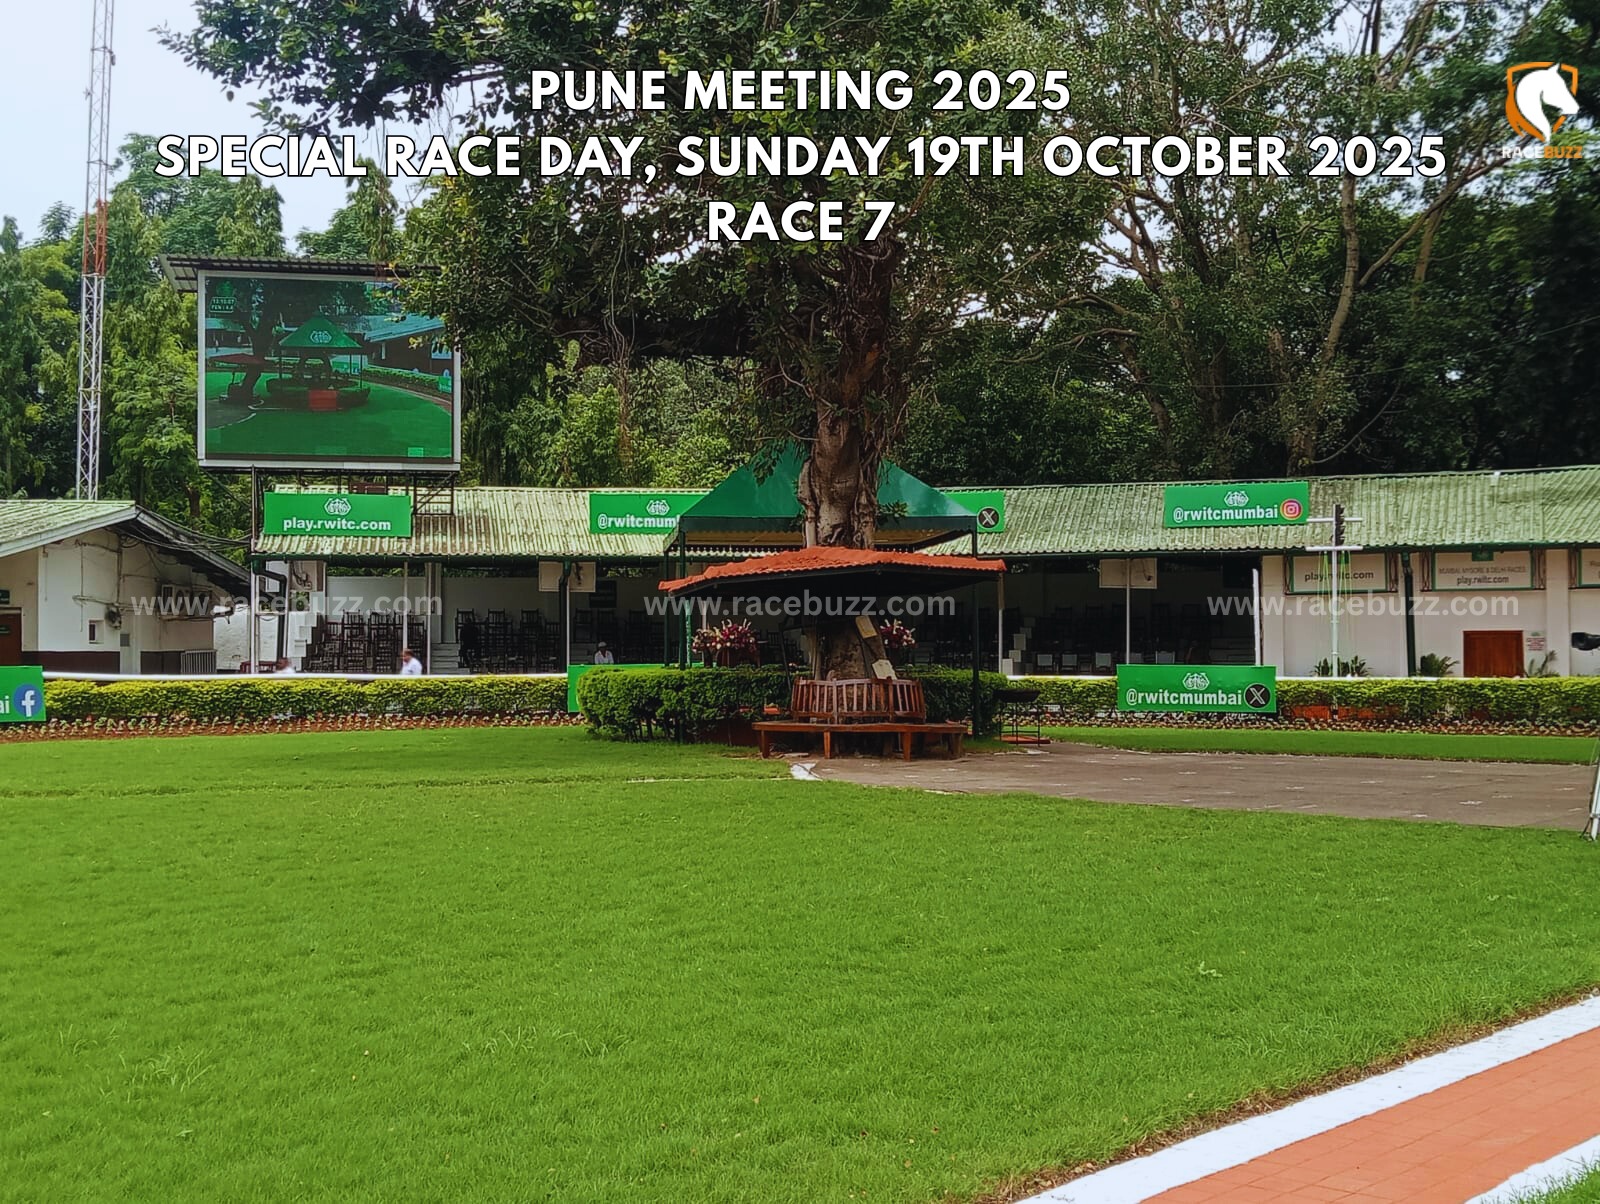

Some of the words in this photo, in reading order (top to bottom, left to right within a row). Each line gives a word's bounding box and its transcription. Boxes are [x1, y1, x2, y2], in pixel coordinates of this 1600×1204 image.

[597, 513, 681, 530] @rwitcmum
[1173, 504, 1278, 523] @rwitcmumbai
[283, 517, 391, 531] play.rwitc.com
[1126, 688, 1242, 706] @rwitcmumbai
